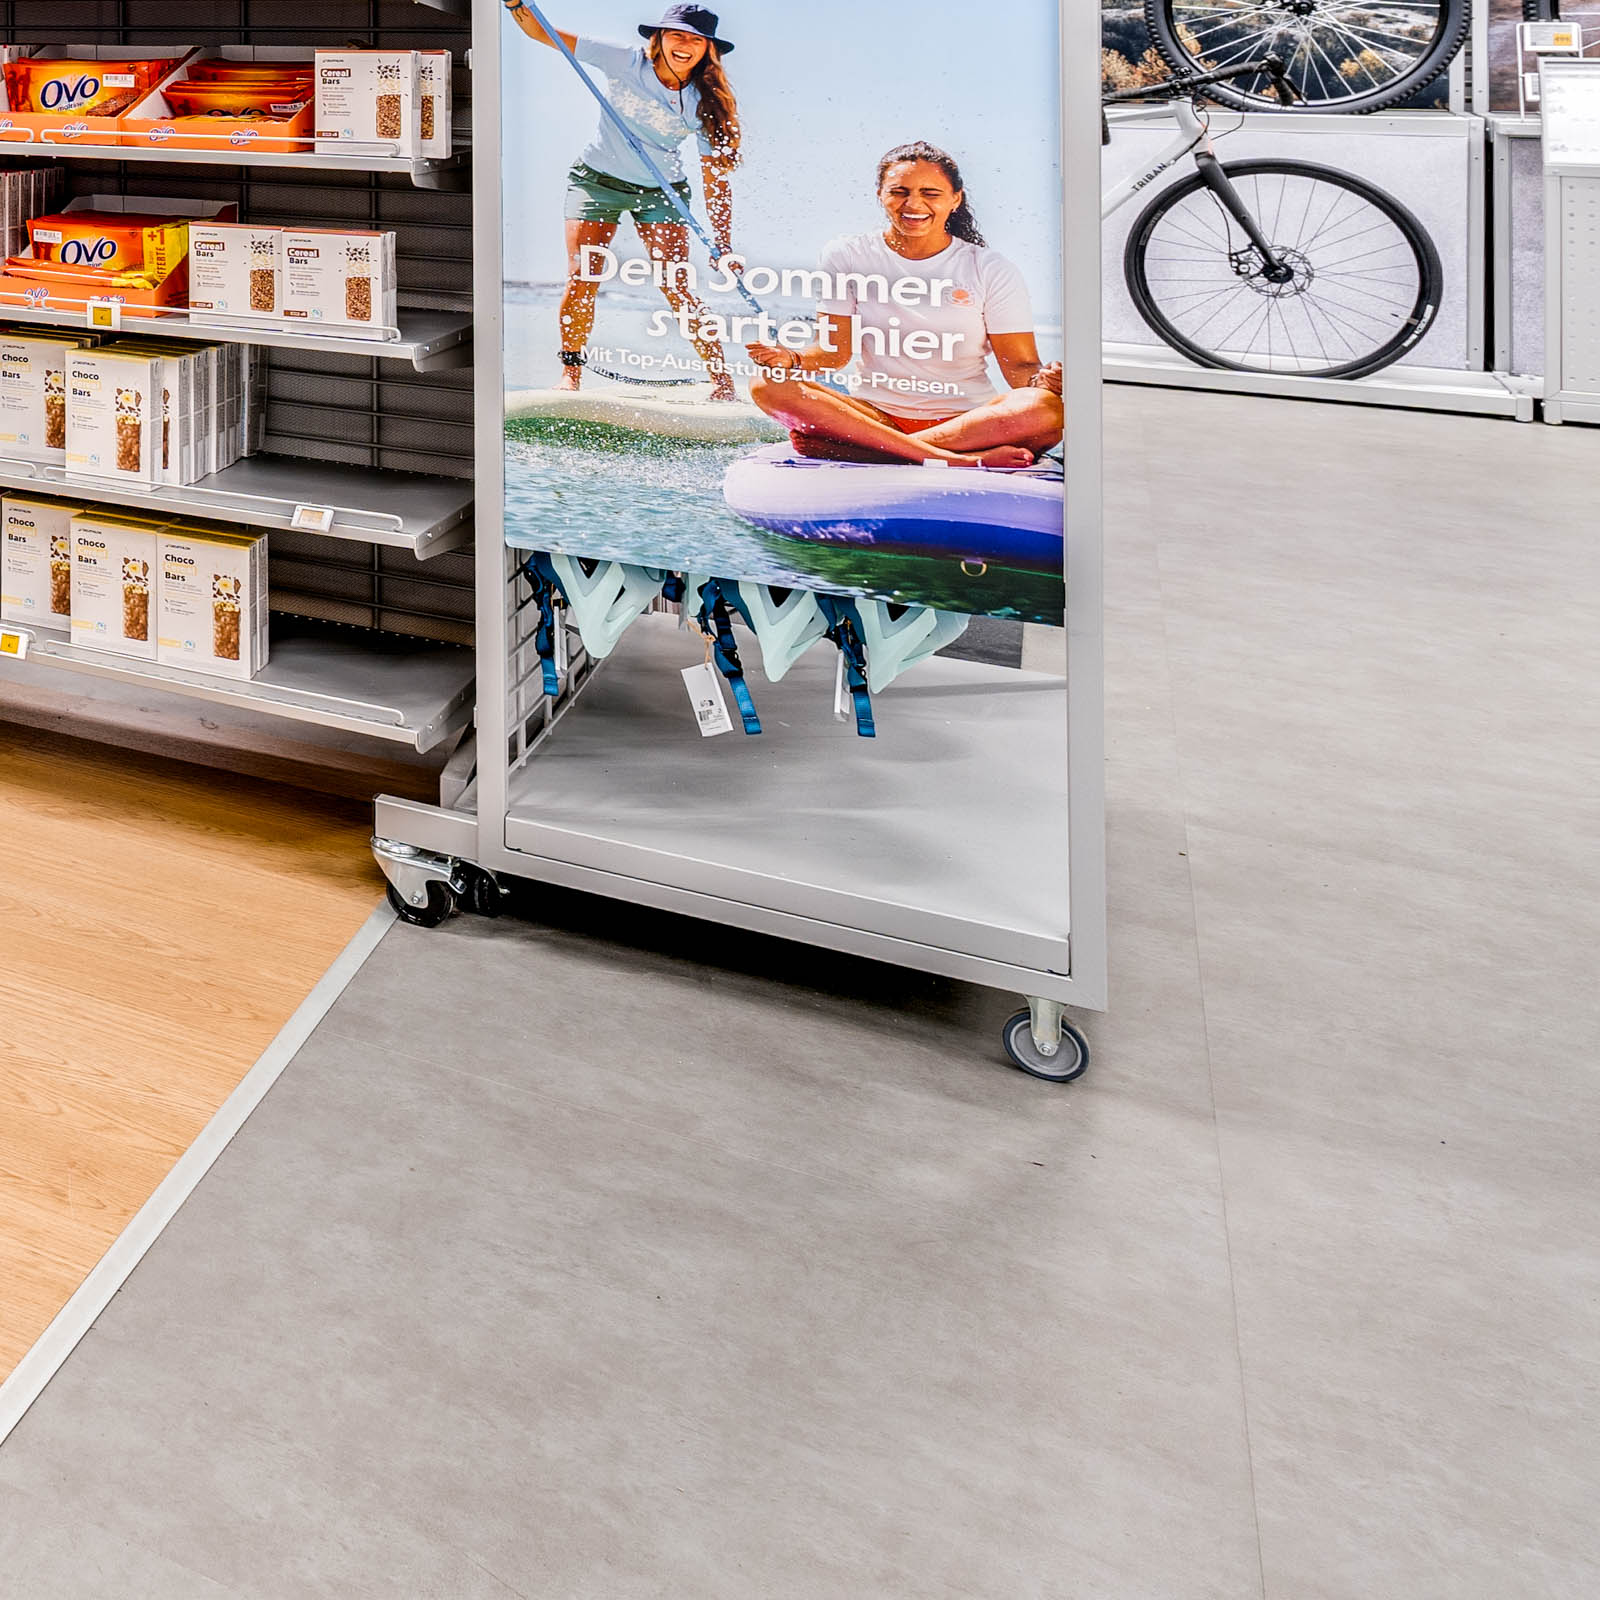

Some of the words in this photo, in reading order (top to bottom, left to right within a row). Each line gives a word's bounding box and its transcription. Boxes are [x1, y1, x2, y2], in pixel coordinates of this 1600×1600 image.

[1131, 162, 1167, 191] TRIBAN
[196, 242, 223, 250] Cereal
[580, 244, 697, 290] Dein
[708, 253, 954, 308] Sommer
[647, 306, 839, 354] startet
[852, 313, 964, 362] hier
[2, 354, 28, 363] Choco
[2, 371, 20, 379] Bars
[72, 371, 99, 380] Choco
[580, 345, 613, 363] Mit
[617, 349, 787, 384] Top-Ausrüstung
[791, 367, 817, 382] zu
[820, 368, 965, 397] Top-Preisen.
[73, 389, 91, 397] Bars
[9, 517, 35, 527] Choco
[9, 534, 26, 542] Bars
[78, 538, 105, 548] Choco
[78, 555, 97, 564] Bars
[165, 554, 194, 565] Choco
[165, 572, 185, 581] Bars
